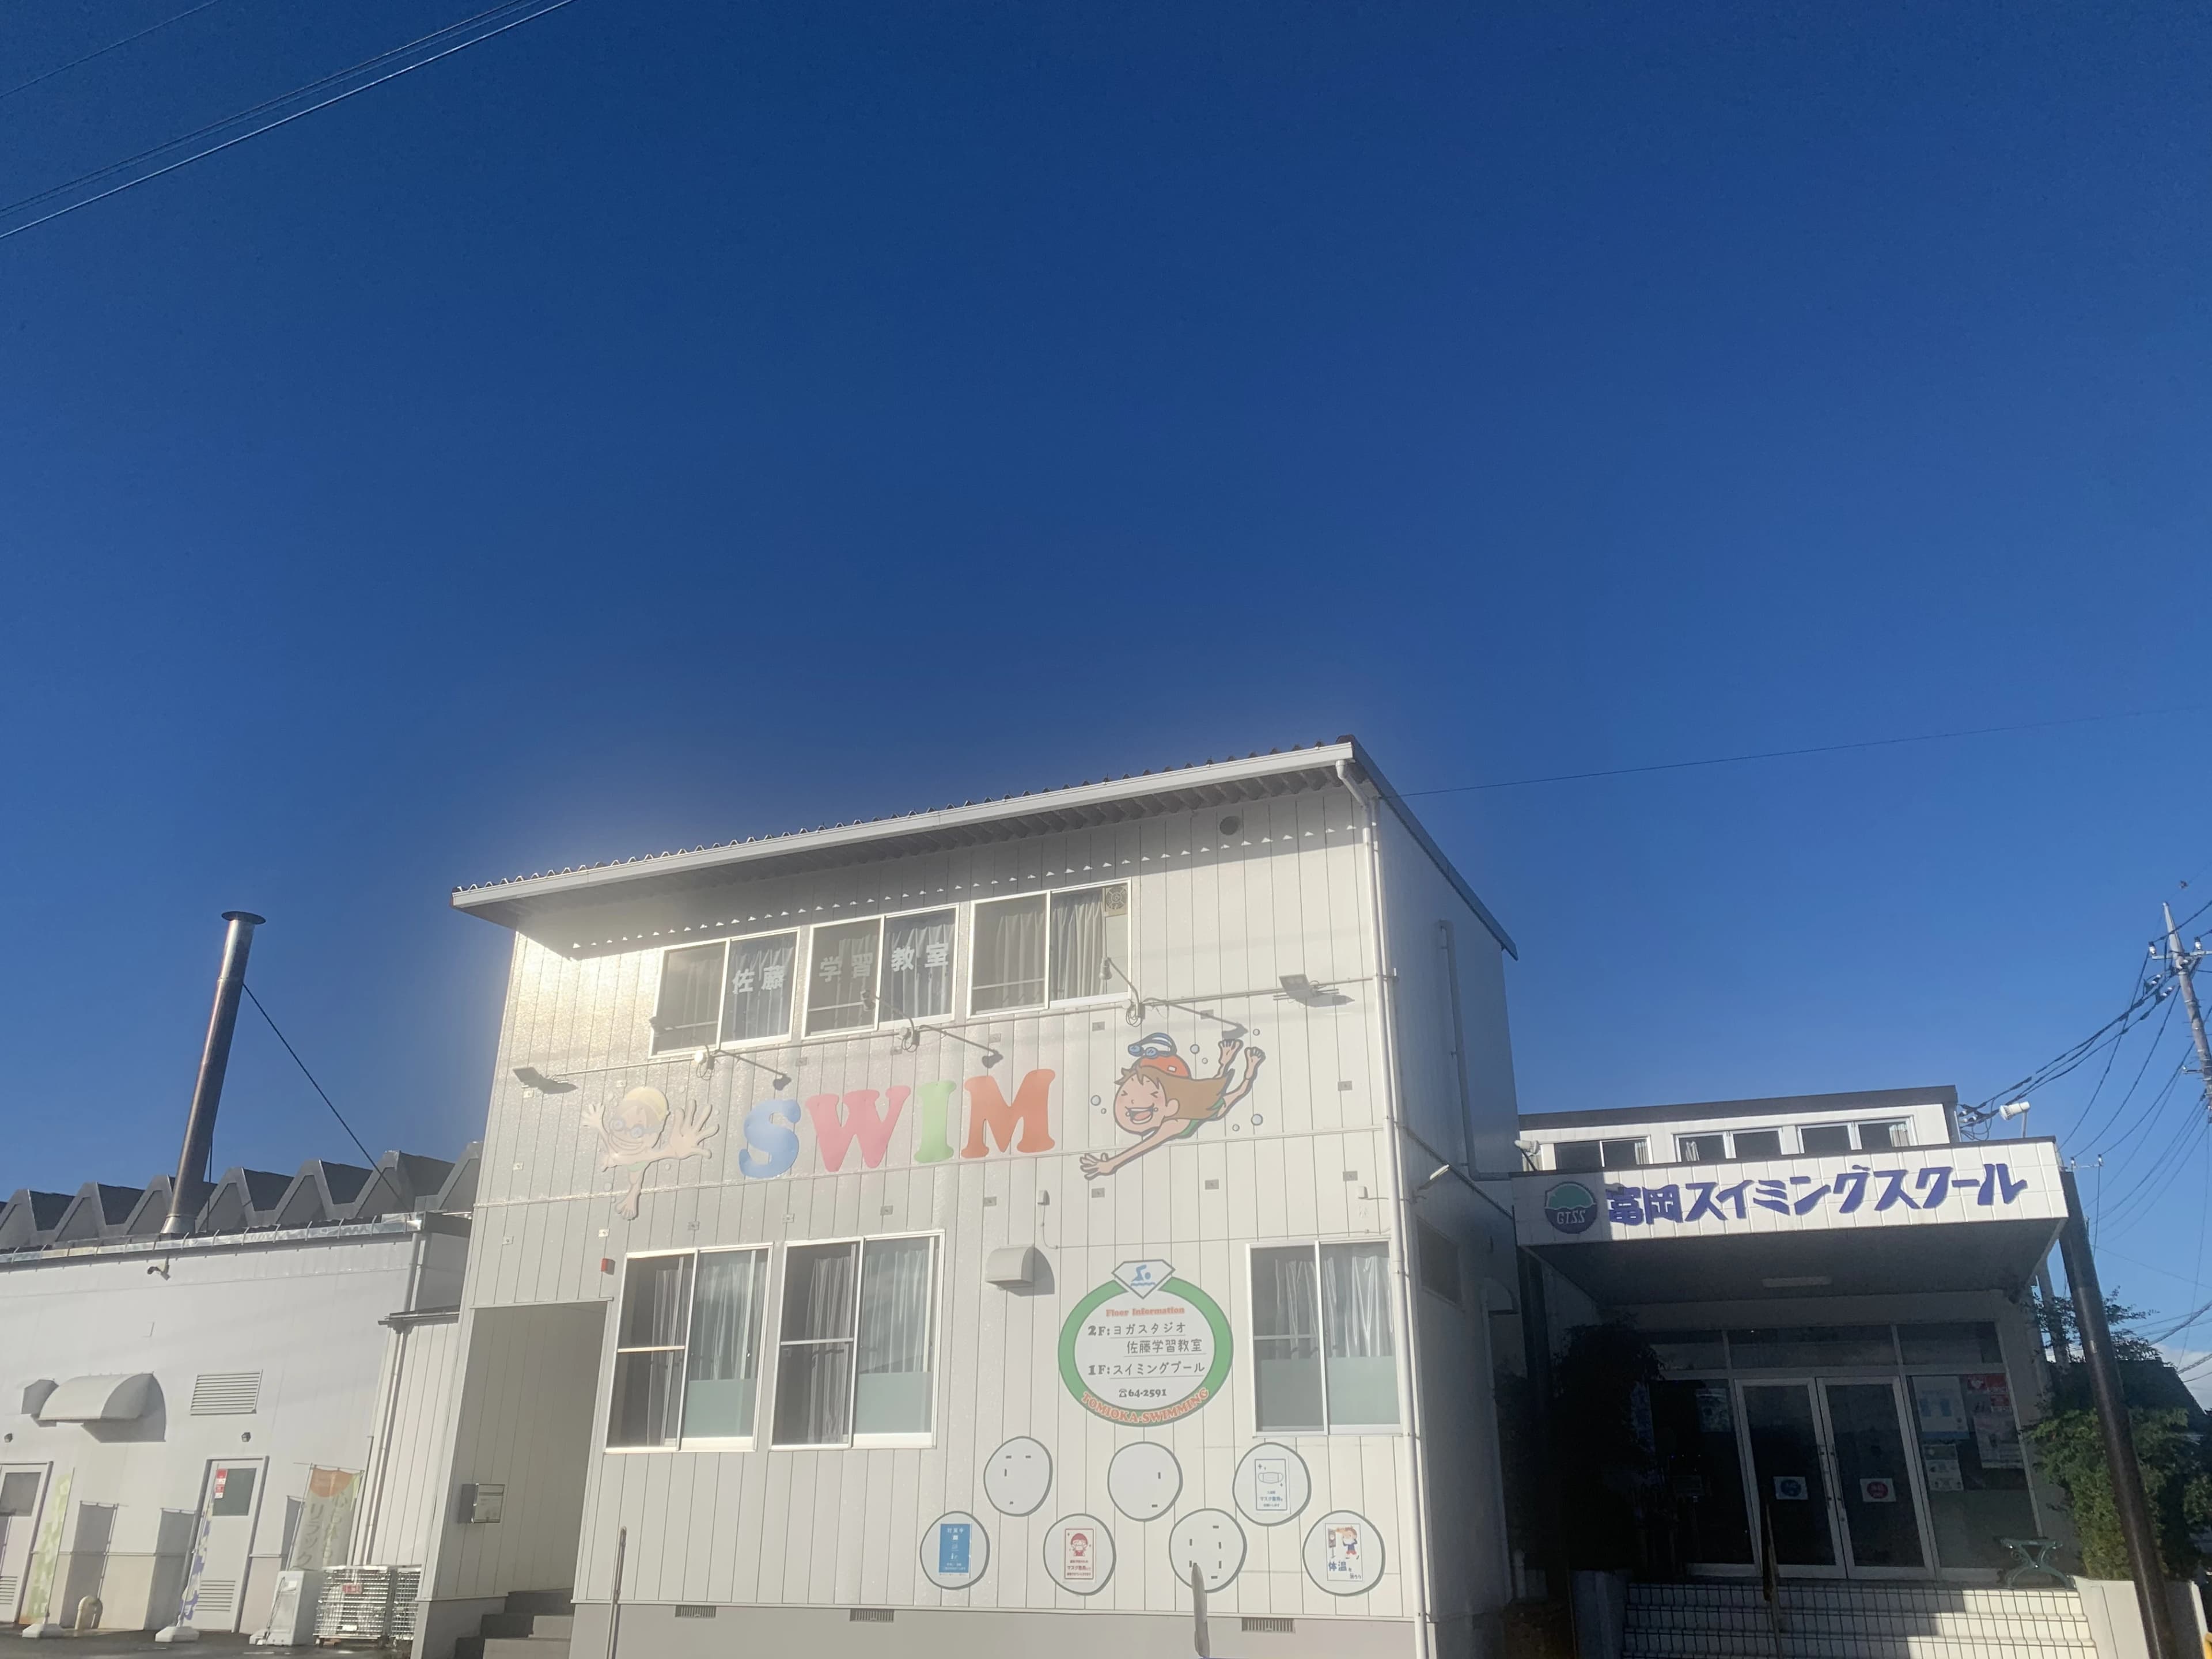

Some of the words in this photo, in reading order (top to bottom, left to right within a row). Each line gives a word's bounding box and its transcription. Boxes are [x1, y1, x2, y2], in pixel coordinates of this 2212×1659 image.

[738, 1069, 1056, 1179] SWIM
[1605, 1164, 2028, 1226] 富岡スイミングスクール
[1106, 1309, 1129, 1317] Floor
[1132, 1306, 1185, 1316] Information
[1127, 1339, 1202, 1354] 佐藤学習教室
